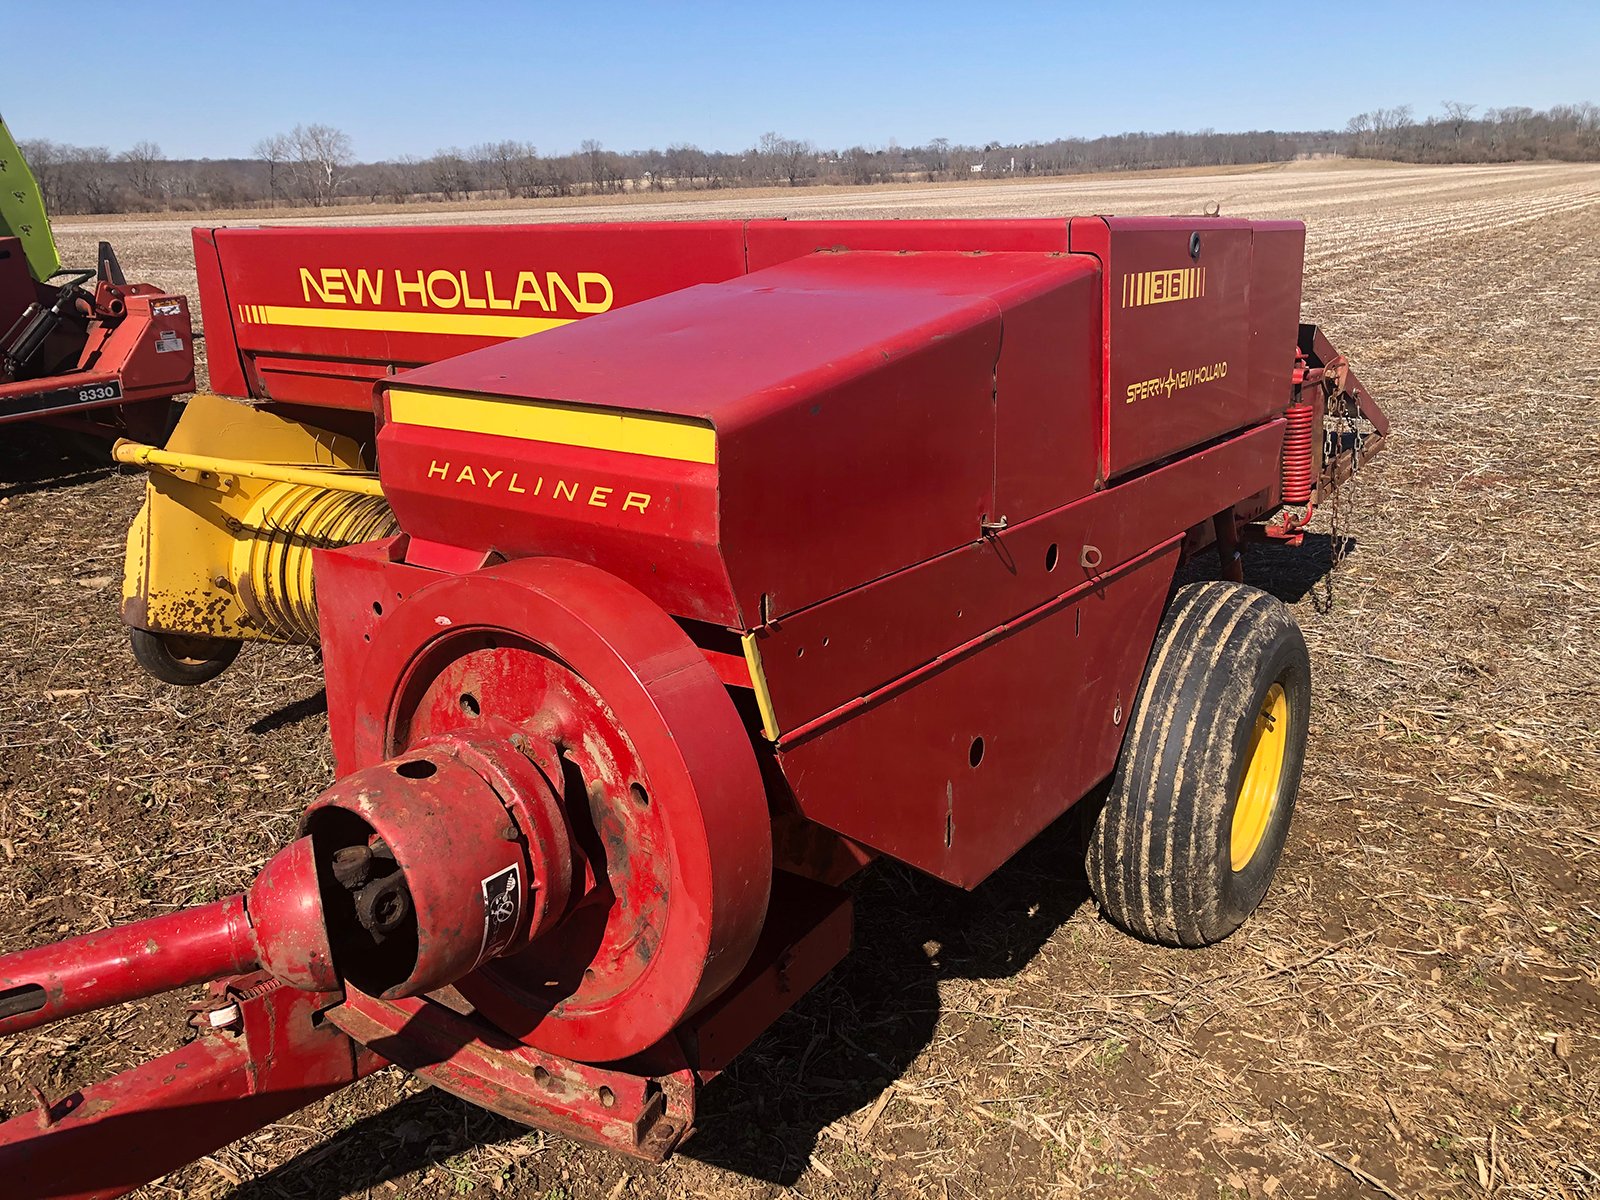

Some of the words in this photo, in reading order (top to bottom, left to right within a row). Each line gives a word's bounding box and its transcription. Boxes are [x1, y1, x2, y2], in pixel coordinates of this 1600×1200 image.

[299, 267, 384, 305] NEW
[396, 270, 614, 313] HOLLAND
[1153, 273, 1182, 300] 316
[79, 387, 115, 402] 8330
[1126, 377, 1167, 404] SPERRY
[1174, 369, 1195, 390] NEW
[1194, 361, 1228, 384] HOLLAND
[427, 460, 652, 514] HAYLINER
